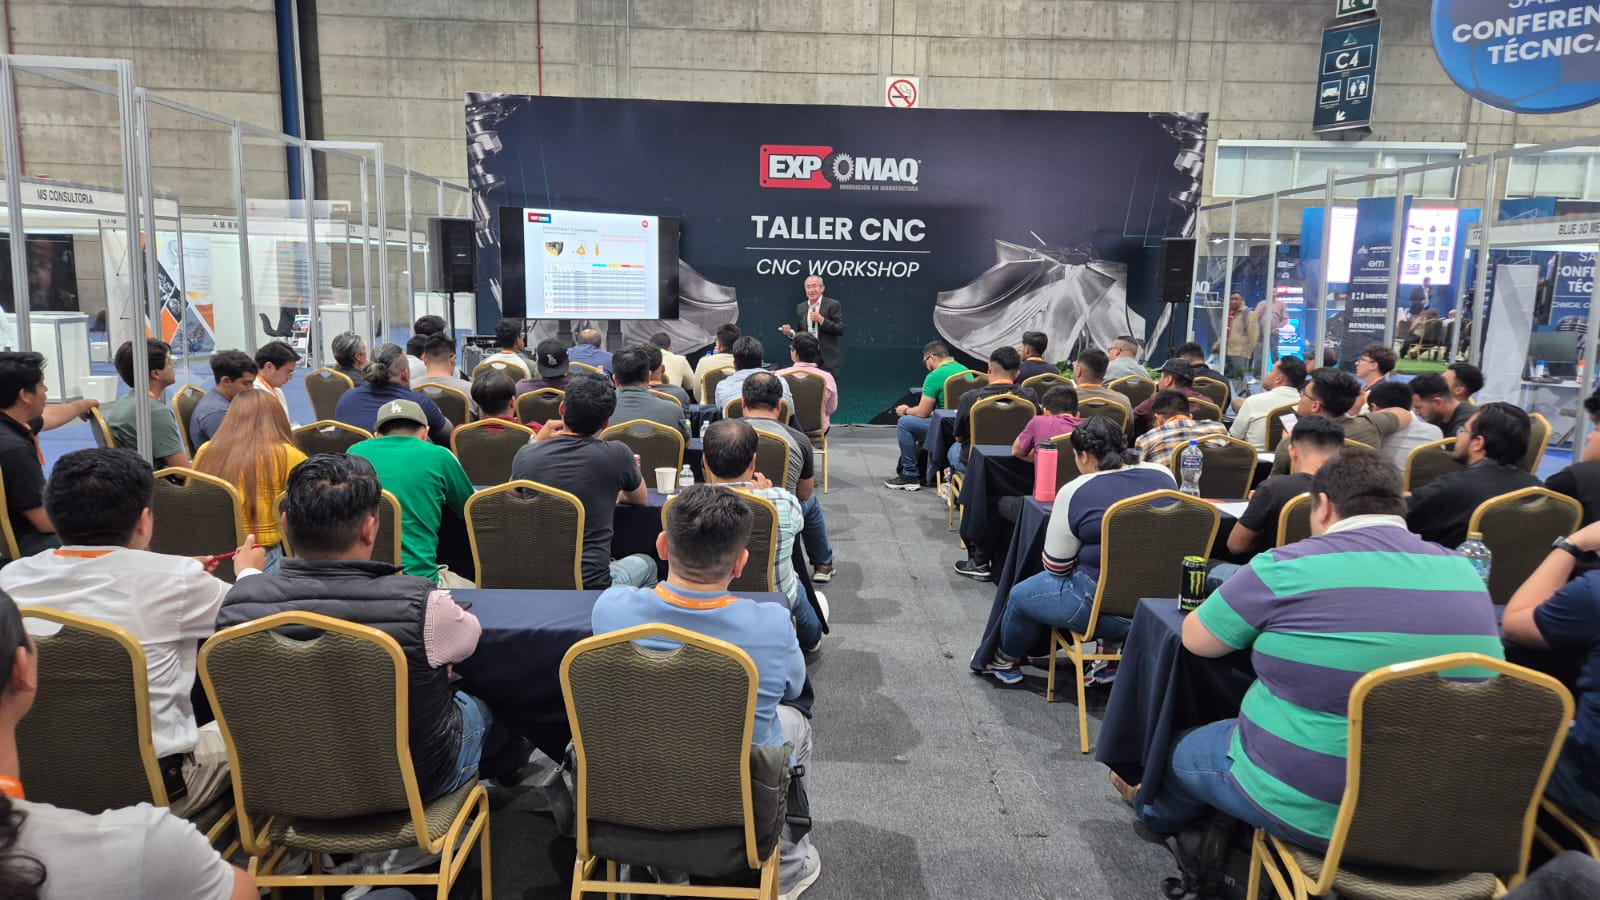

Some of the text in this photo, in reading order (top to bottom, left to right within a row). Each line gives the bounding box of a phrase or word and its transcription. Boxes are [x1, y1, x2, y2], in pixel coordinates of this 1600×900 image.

[1452, 6, 1600, 43] CONFEREN
[1488, 33, 1600, 65] TÉCNIC
[1336, 50, 1359, 70] C4
[751, 215, 926, 242] TALLER CNC
[1558, 223, 1577, 235] BLUE
[757, 258, 920, 277] CNC WORKSHOP
[1568, 278, 1594, 292] TÉC
